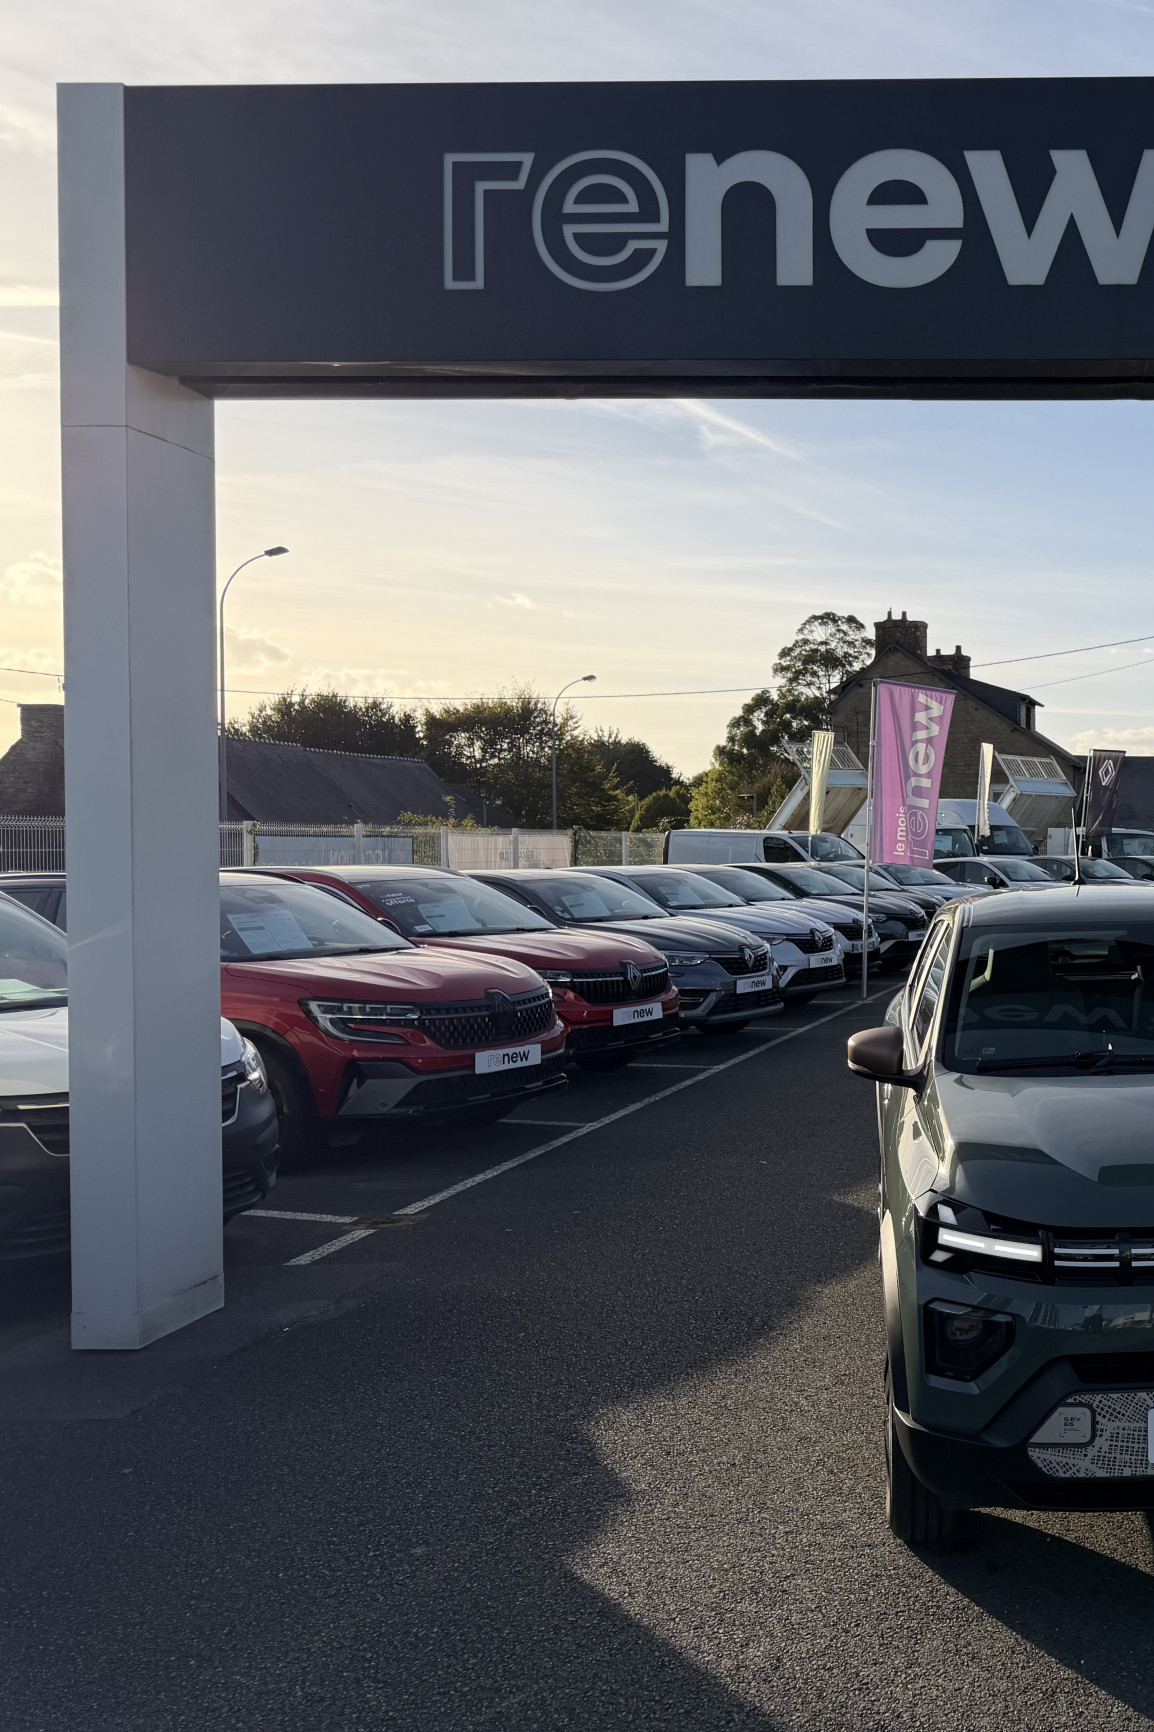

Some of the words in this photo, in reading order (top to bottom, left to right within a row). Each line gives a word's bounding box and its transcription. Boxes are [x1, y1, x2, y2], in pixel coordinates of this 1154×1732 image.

[906, 692, 945, 860] renew
[895, 805, 907, 843] mois
[893, 844, 905, 856] le
[487, 1049, 530, 1067] renew
